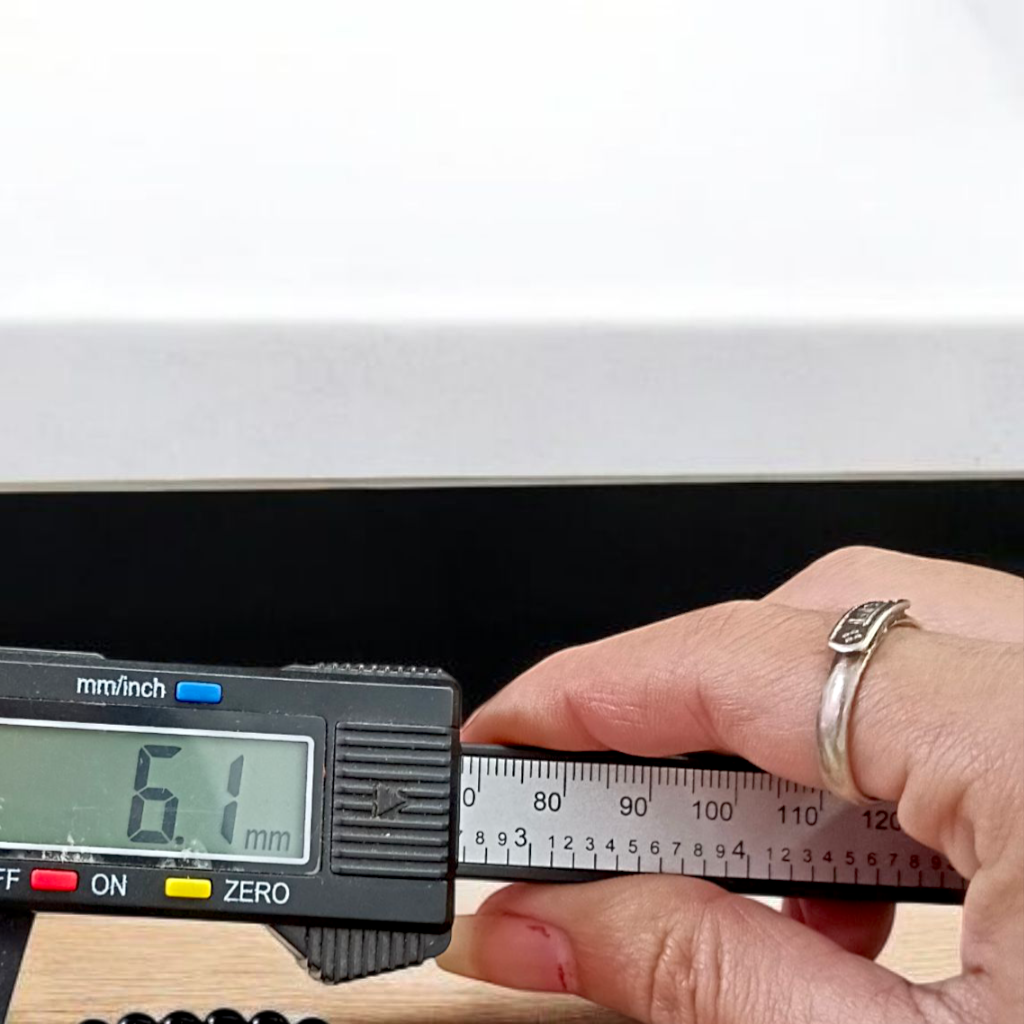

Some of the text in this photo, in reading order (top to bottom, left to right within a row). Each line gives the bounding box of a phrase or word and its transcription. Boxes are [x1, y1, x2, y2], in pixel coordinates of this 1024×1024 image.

[76, 675, 167, 699] mm/inch
[127, 744, 291, 852] 6.1 mm
[533, 791, 562, 812] 80
[619, 796, 648, 817] 90
[692, 800, 734, 822] 100
[777, 805, 819, 827] 110
[475, 831, 485, 845] 8
[497, 832, 508, 846] 9
[514, 827, 528, 848] 3
[548, 835, 555, 849] 1
[563, 835, 574, 850] 2
[585, 836, 595, 851] 3
[605, 838, 616, 853] 4
[628, 839, 638, 854] 5
[650, 840, 660, 855] 6
[672, 841, 682, 857] 7
[693, 842, 703, 857] 8
[715, 844, 726, 859] 9
[732, 840, 746, 860] 4
[766, 847, 773, 860] 1
[781, 848, 791, 862] 2
[803, 849, 813, 864] 3
[822, 851, 833, 864] 4
[845, 851, 856, 866] 5
[867, 852, 877, 867] 6
[889, 853, 899, 867] 7
[909, 854, 920, 869] 8
[931, 856, 942, 871] 9
[91, 873, 128, 897] ON
[223, 878, 290, 904] ZERO
